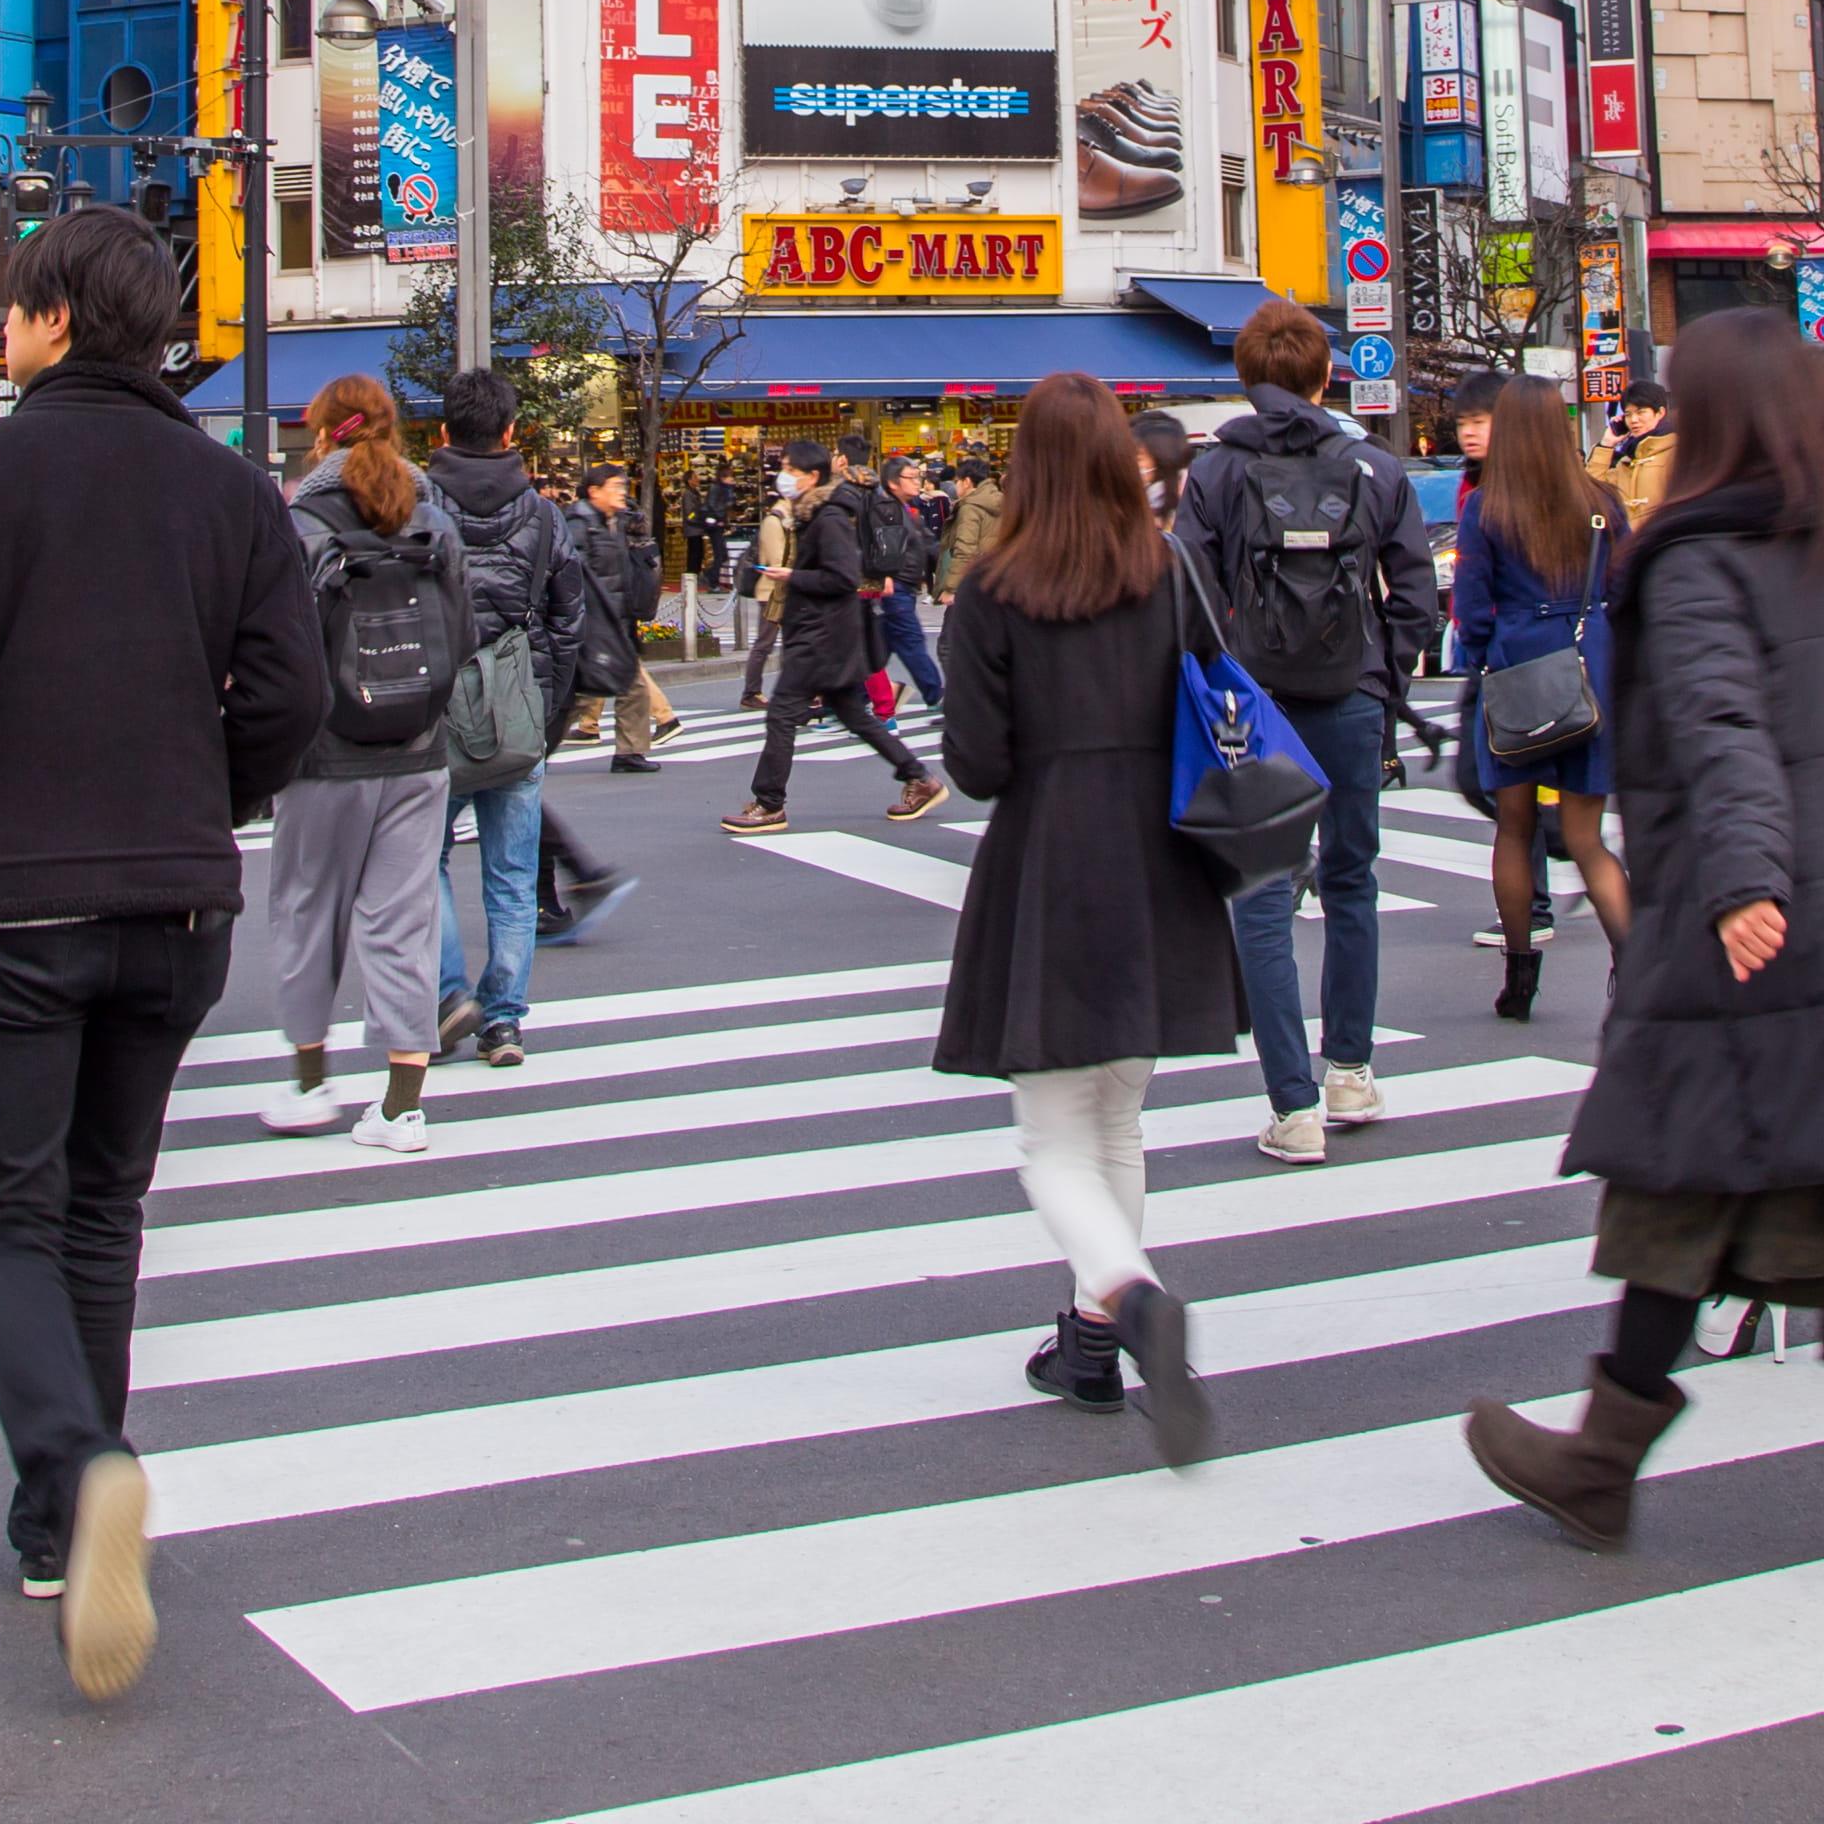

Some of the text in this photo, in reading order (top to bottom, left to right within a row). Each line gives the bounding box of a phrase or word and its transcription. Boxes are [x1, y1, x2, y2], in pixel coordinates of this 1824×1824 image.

[379, 43, 454, 100] 分煙で
[1432, 77, 1457, 96] 3F
[789, 77, 1019, 127] superstar
[380, 122, 432, 172] 街に。
[763, 223, 1045, 285] ABC-MART
[1585, 370, 1624, 399] 買取
